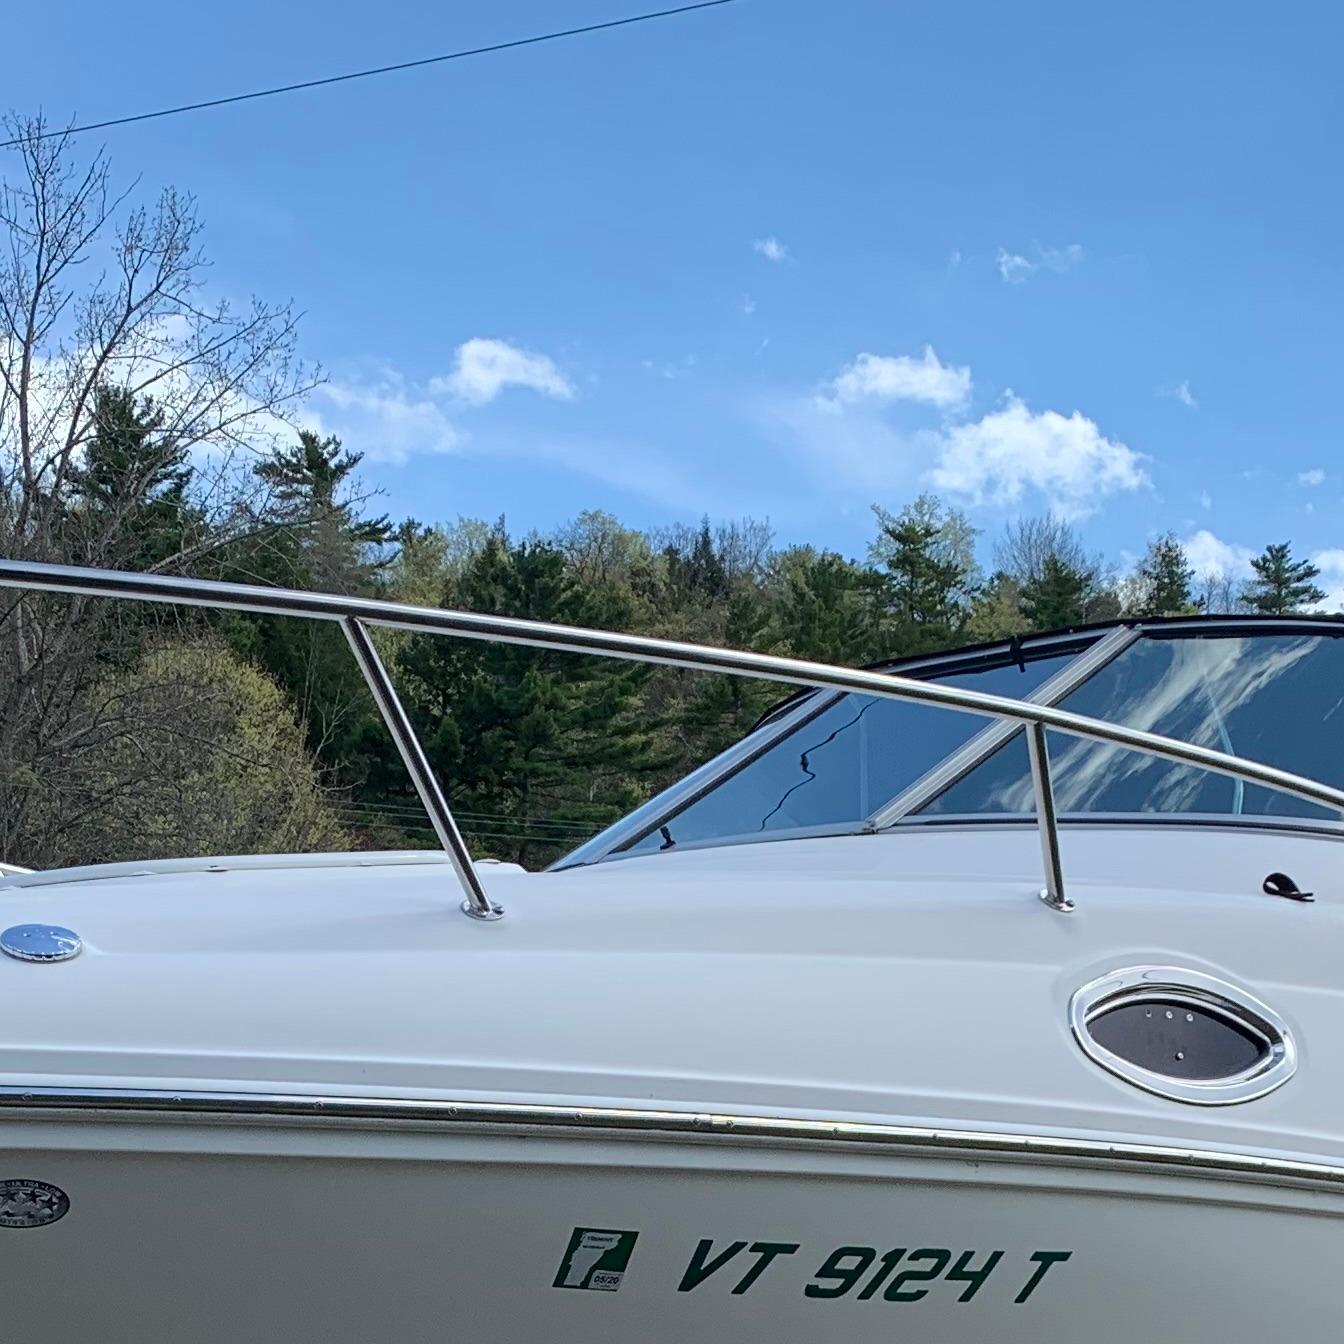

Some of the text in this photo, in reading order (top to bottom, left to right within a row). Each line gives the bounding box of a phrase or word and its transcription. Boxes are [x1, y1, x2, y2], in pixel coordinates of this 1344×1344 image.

[677, 1238, 1073, 1304] VT 9124 T
